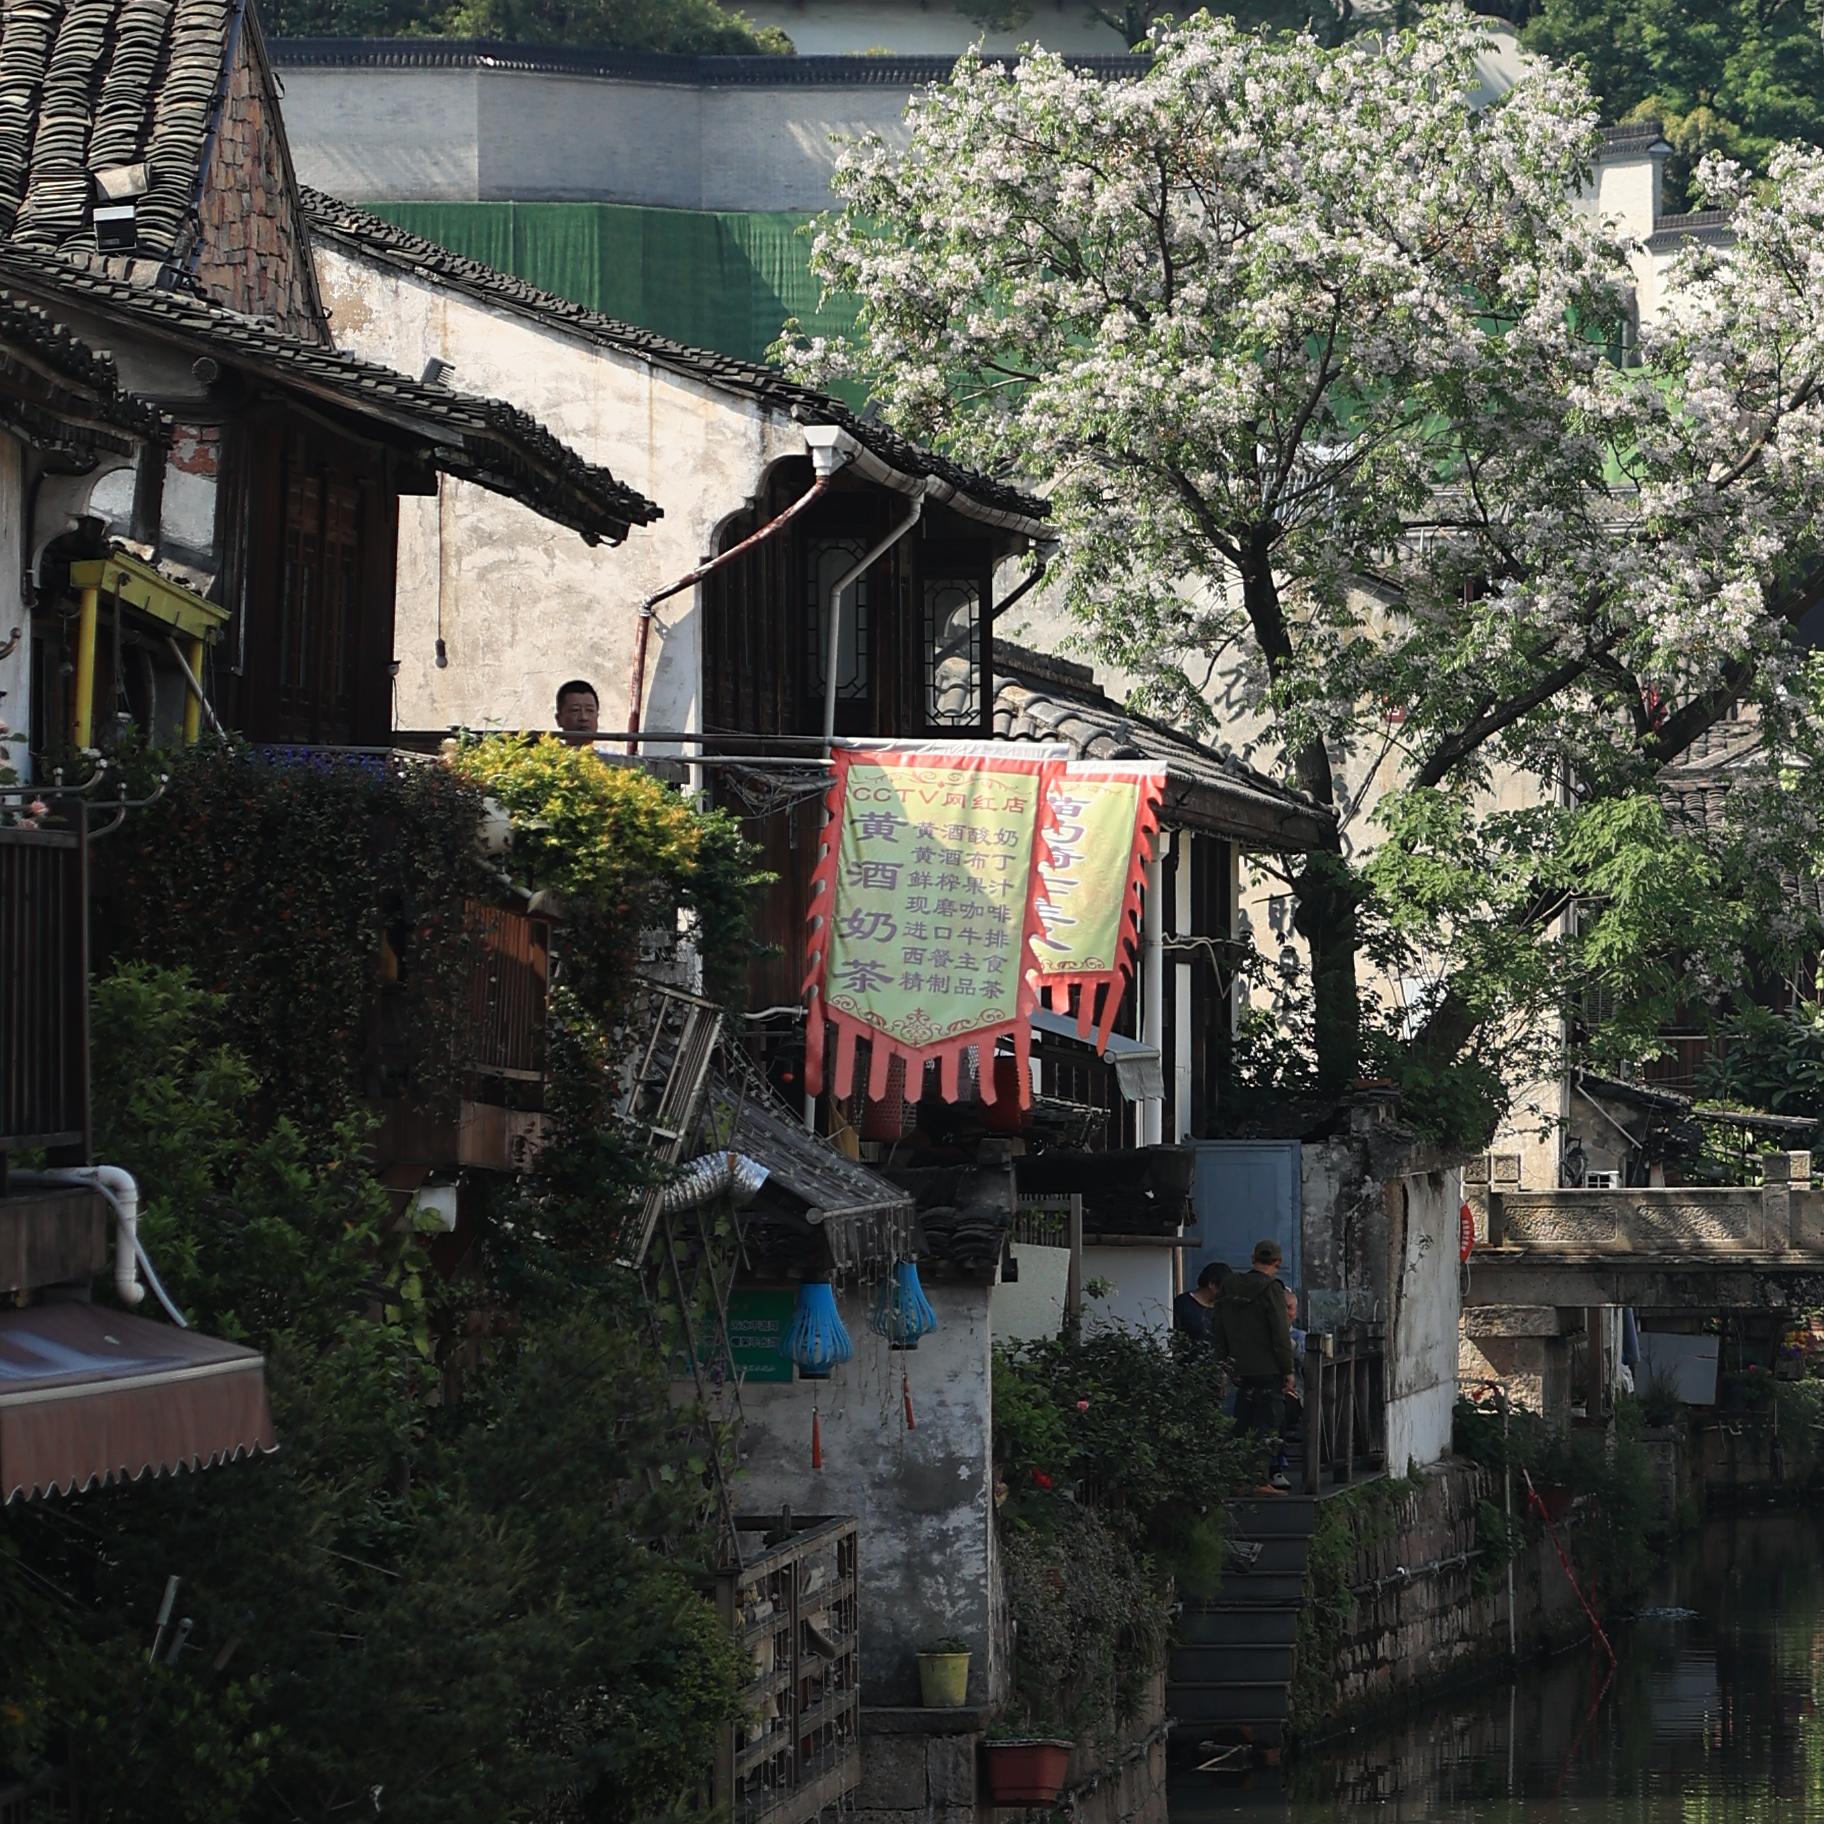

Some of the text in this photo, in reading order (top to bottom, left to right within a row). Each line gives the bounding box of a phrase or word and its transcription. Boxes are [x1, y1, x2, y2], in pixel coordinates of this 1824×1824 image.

[852, 787, 1028, 814] CCTV网红店
[913, 821, 1019, 848] 黄酒酸奶
[910, 846, 1016, 871] 黄酒布丁
[907, 871, 1014, 897] 鲜榨果汁
[833, 811, 909, 994] 黄酒奶茶
[905, 896, 1011, 923] 现磨咖啡
[903, 921, 1010, 948] 进口牛排
[901, 946, 1008, 974] 西餐主食
[898, 971, 1005, 999] 精制品茶
